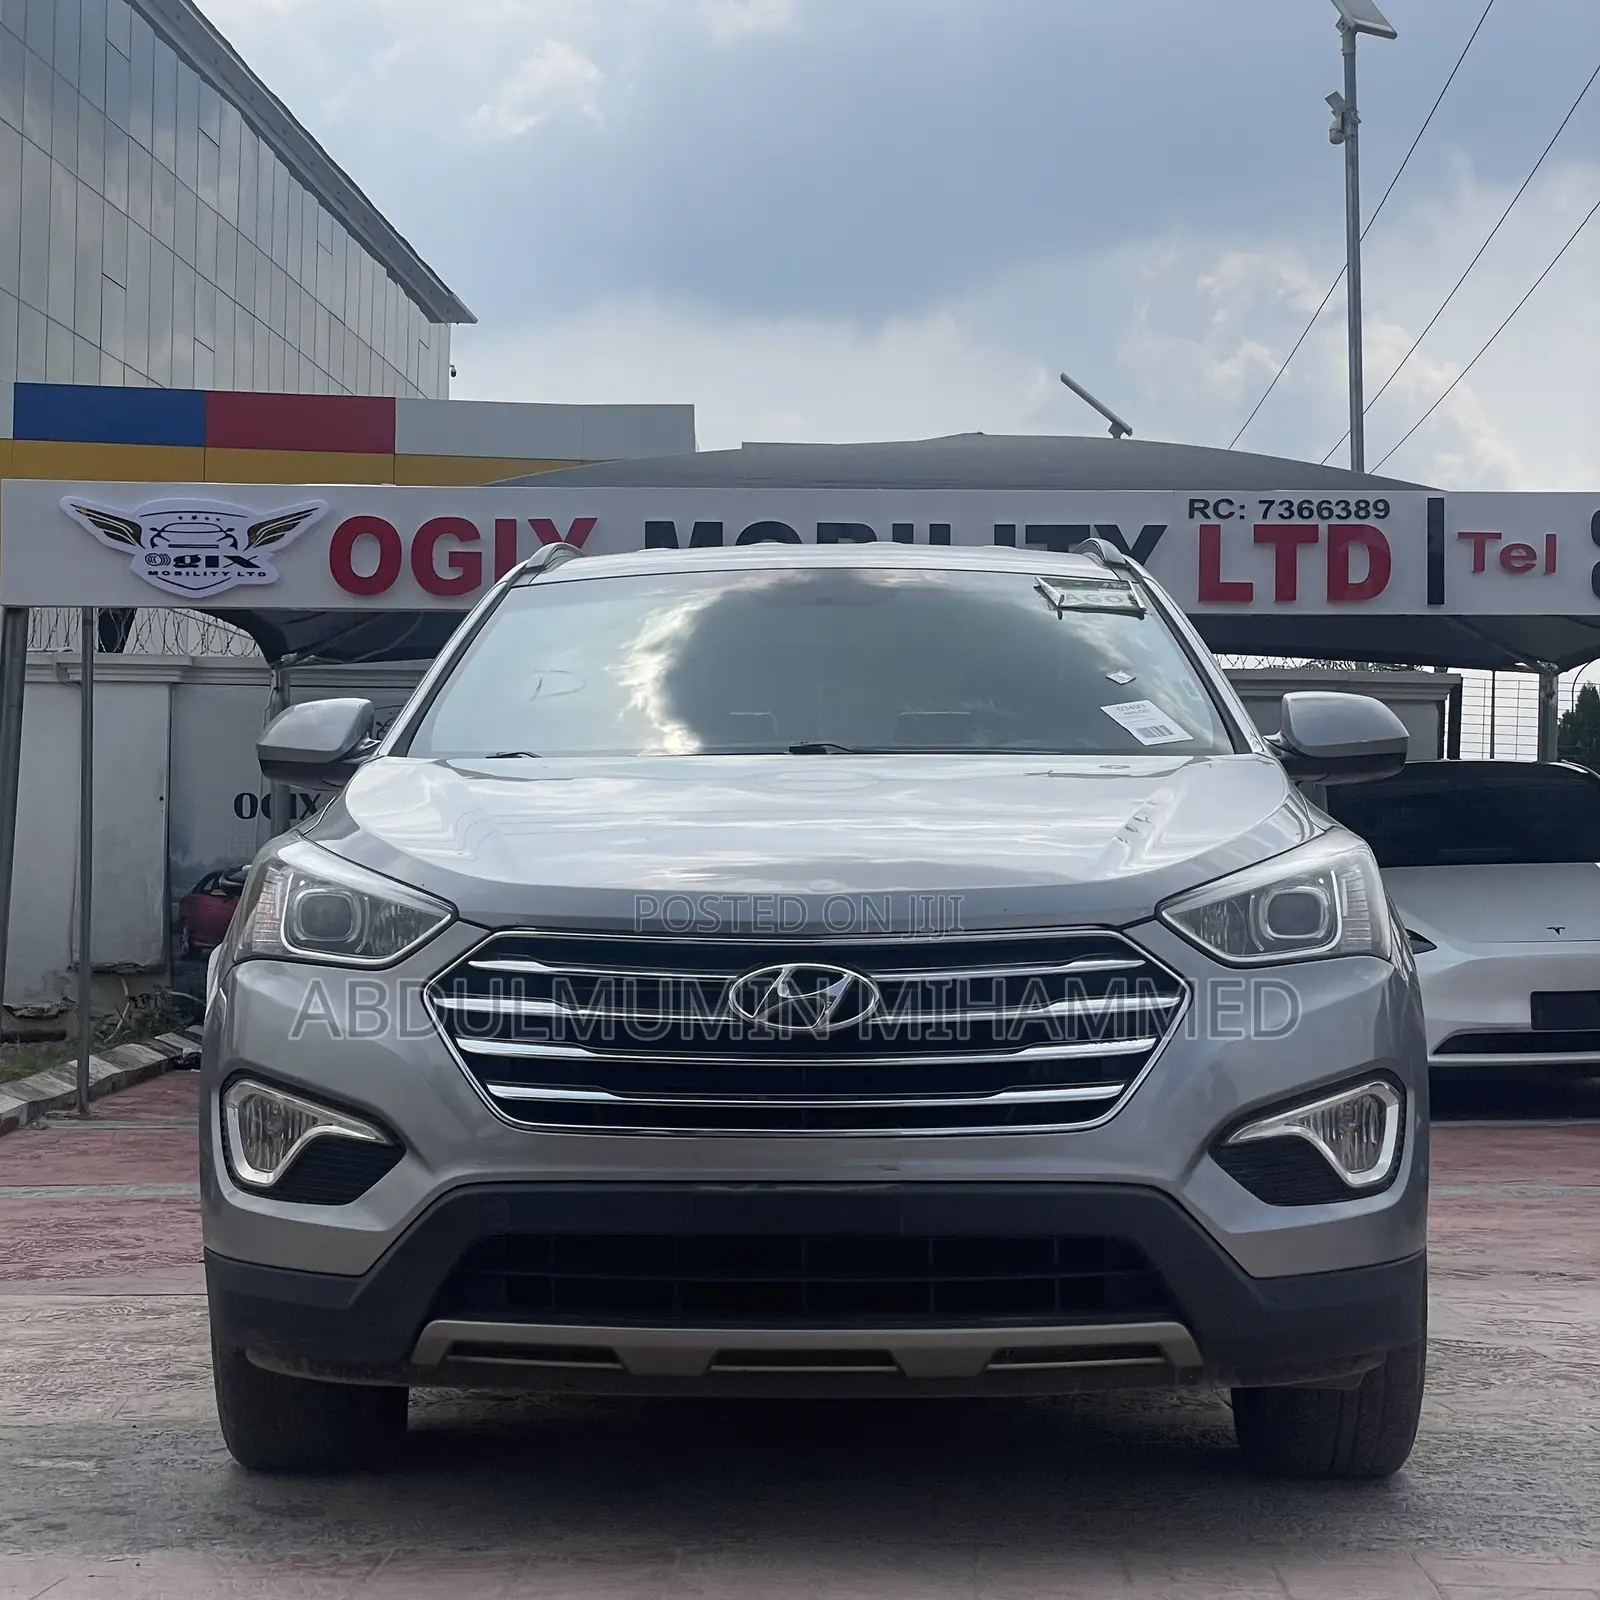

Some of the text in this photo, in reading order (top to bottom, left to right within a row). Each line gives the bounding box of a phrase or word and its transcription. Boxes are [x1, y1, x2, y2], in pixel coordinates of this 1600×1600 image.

[1188, 499, 1391, 520] RC: 7366389
[1198, 524, 1392, 604] LTD
[1457, 532, 1557, 574] Tel
